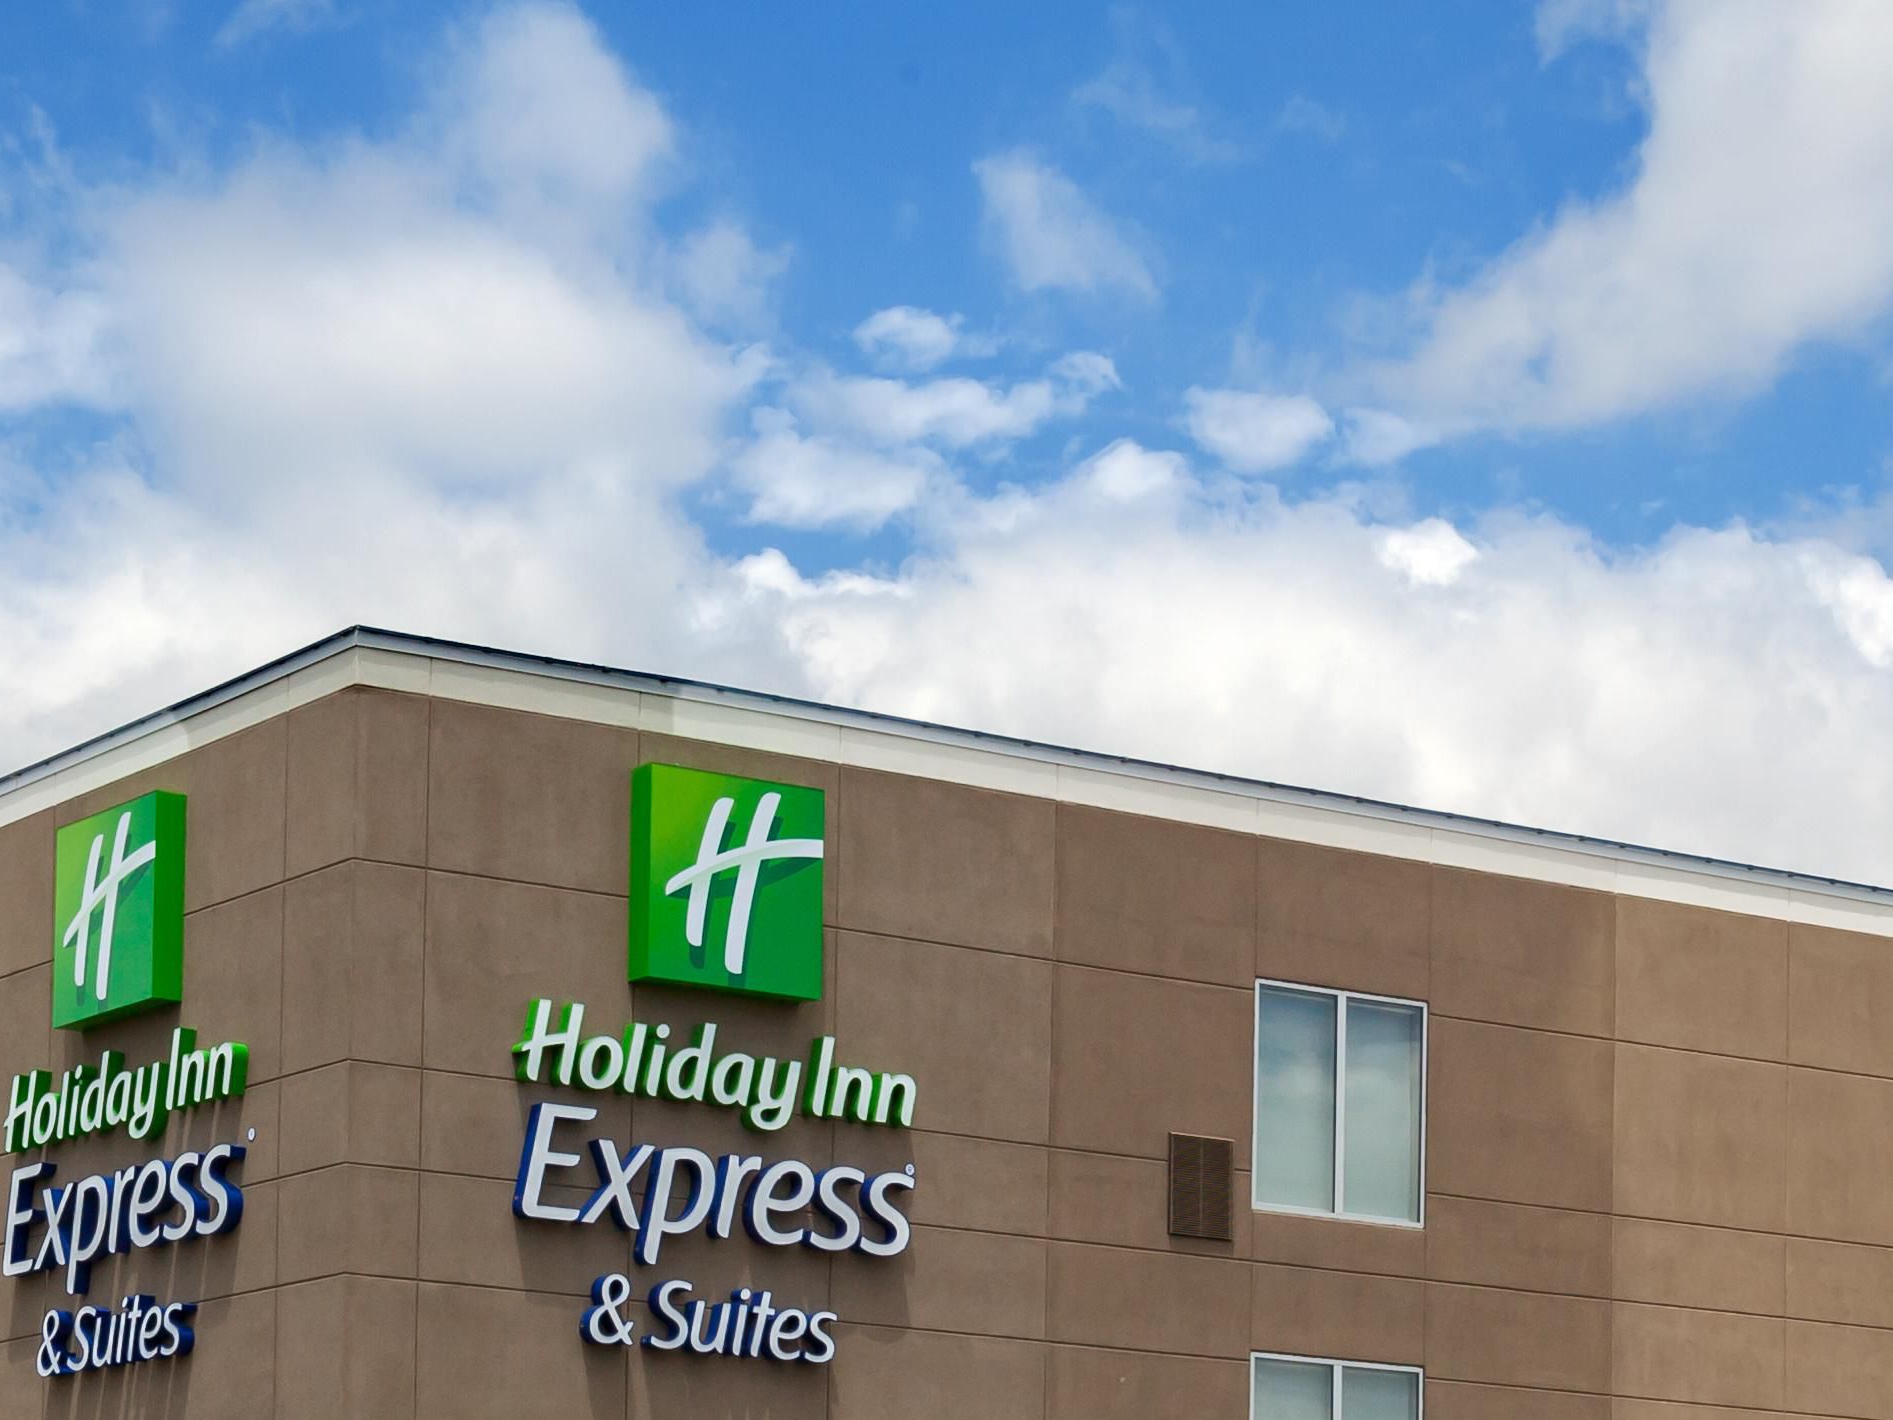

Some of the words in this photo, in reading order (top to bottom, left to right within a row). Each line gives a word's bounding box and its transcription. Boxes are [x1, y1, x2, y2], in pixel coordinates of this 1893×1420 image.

[3, 1050, 164, 1153] Holiday
[165, 1027, 244, 1111] Inn
[513, 998, 802, 1131] Holiday
[806, 1036, 917, 1127] Inn
[2, 1143, 242, 1296] Express
[514, 1101, 916, 1265] Express
[36, 1309, 69, 1378] &
[67, 1294, 191, 1373] Suites
[583, 1273, 635, 1346] &
[642, 1278, 839, 1363] Suites
